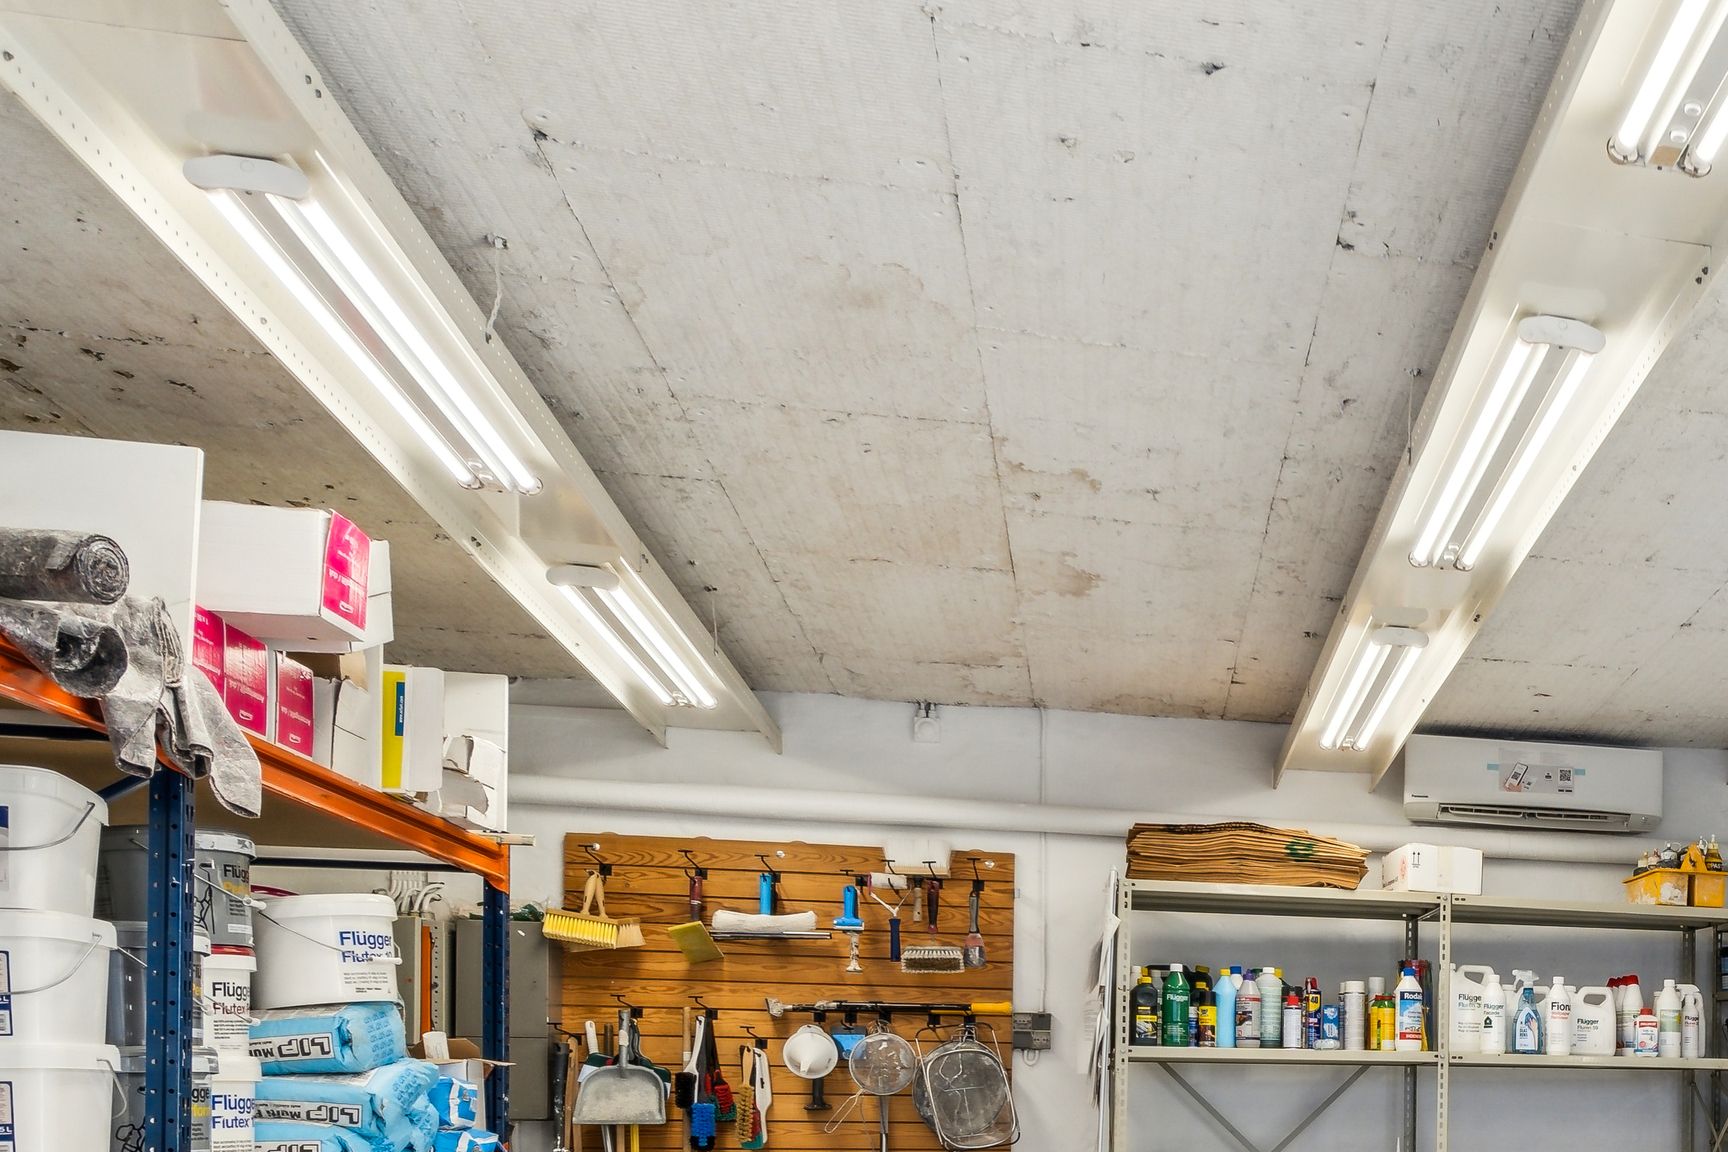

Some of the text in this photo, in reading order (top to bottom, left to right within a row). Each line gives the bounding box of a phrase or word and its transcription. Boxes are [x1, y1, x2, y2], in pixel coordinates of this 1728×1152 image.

[339, 931, 392, 949] Flügger
[212, 982, 250, 1001] Flügge
[1458, 993, 1482, 1002] Flügge
[212, 1116, 249, 1129] Flutex
